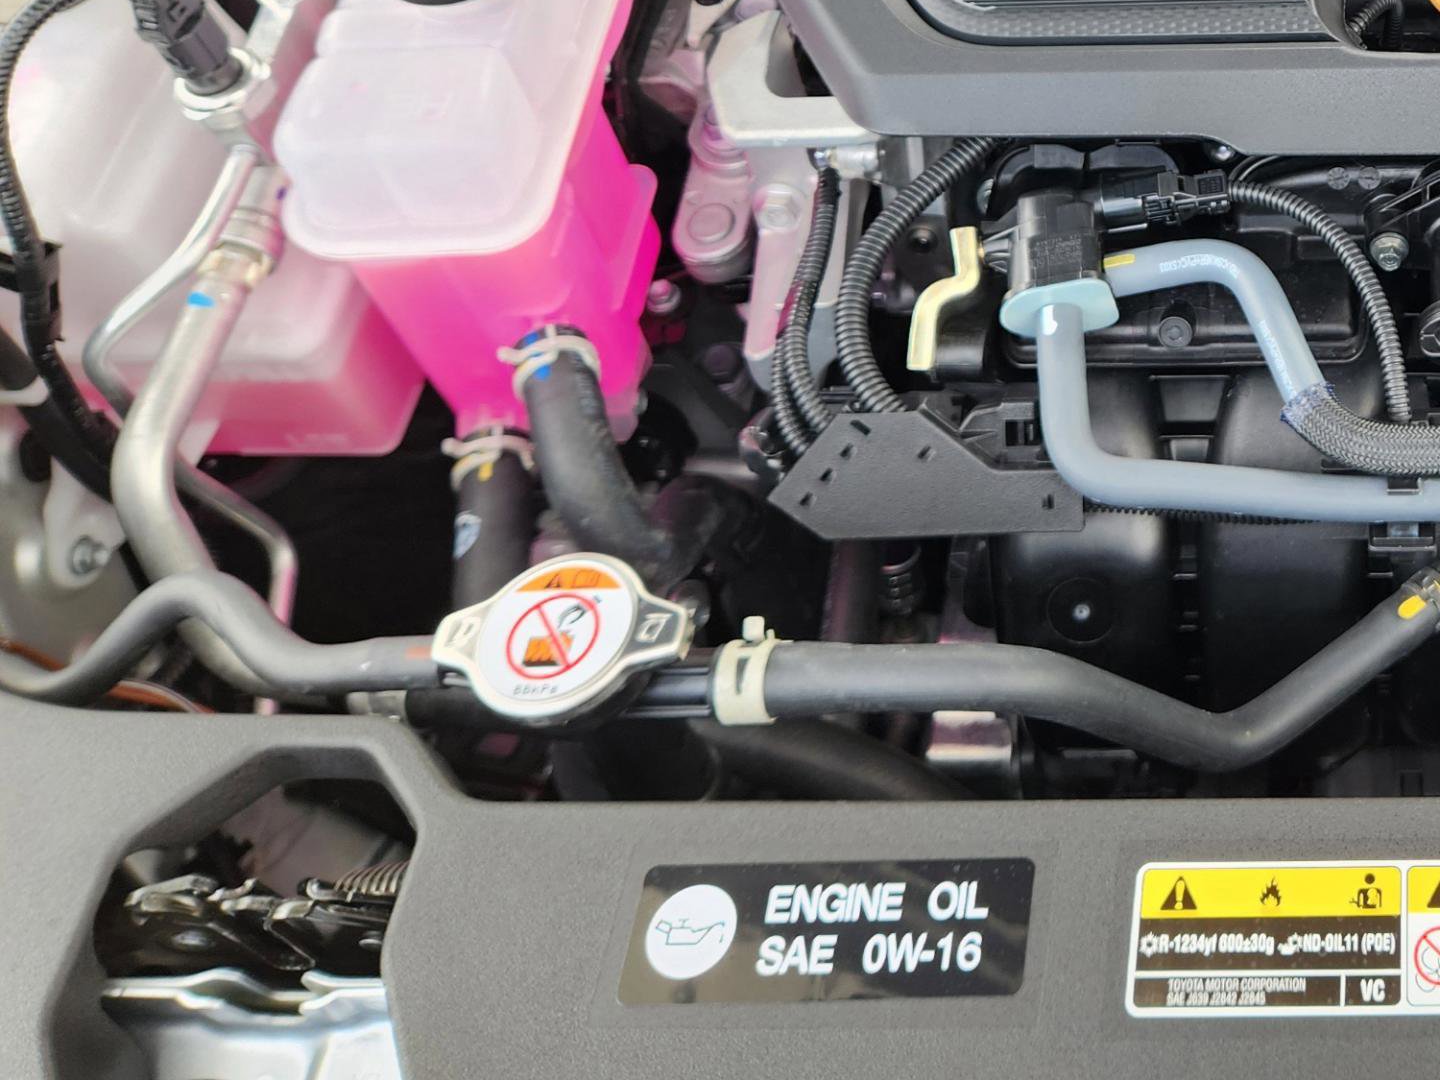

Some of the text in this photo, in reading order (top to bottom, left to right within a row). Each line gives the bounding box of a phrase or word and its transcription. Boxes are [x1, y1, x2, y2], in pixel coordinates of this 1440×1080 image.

[764, 880, 990, 924] ENGINE OIL
[755, 931, 983, 976] SAE 0W-16
[1361, 932, 1396, 955] (POE)
[1168, 976, 1386, 1002] TOYOTA MOTOR CORPORATION VC
